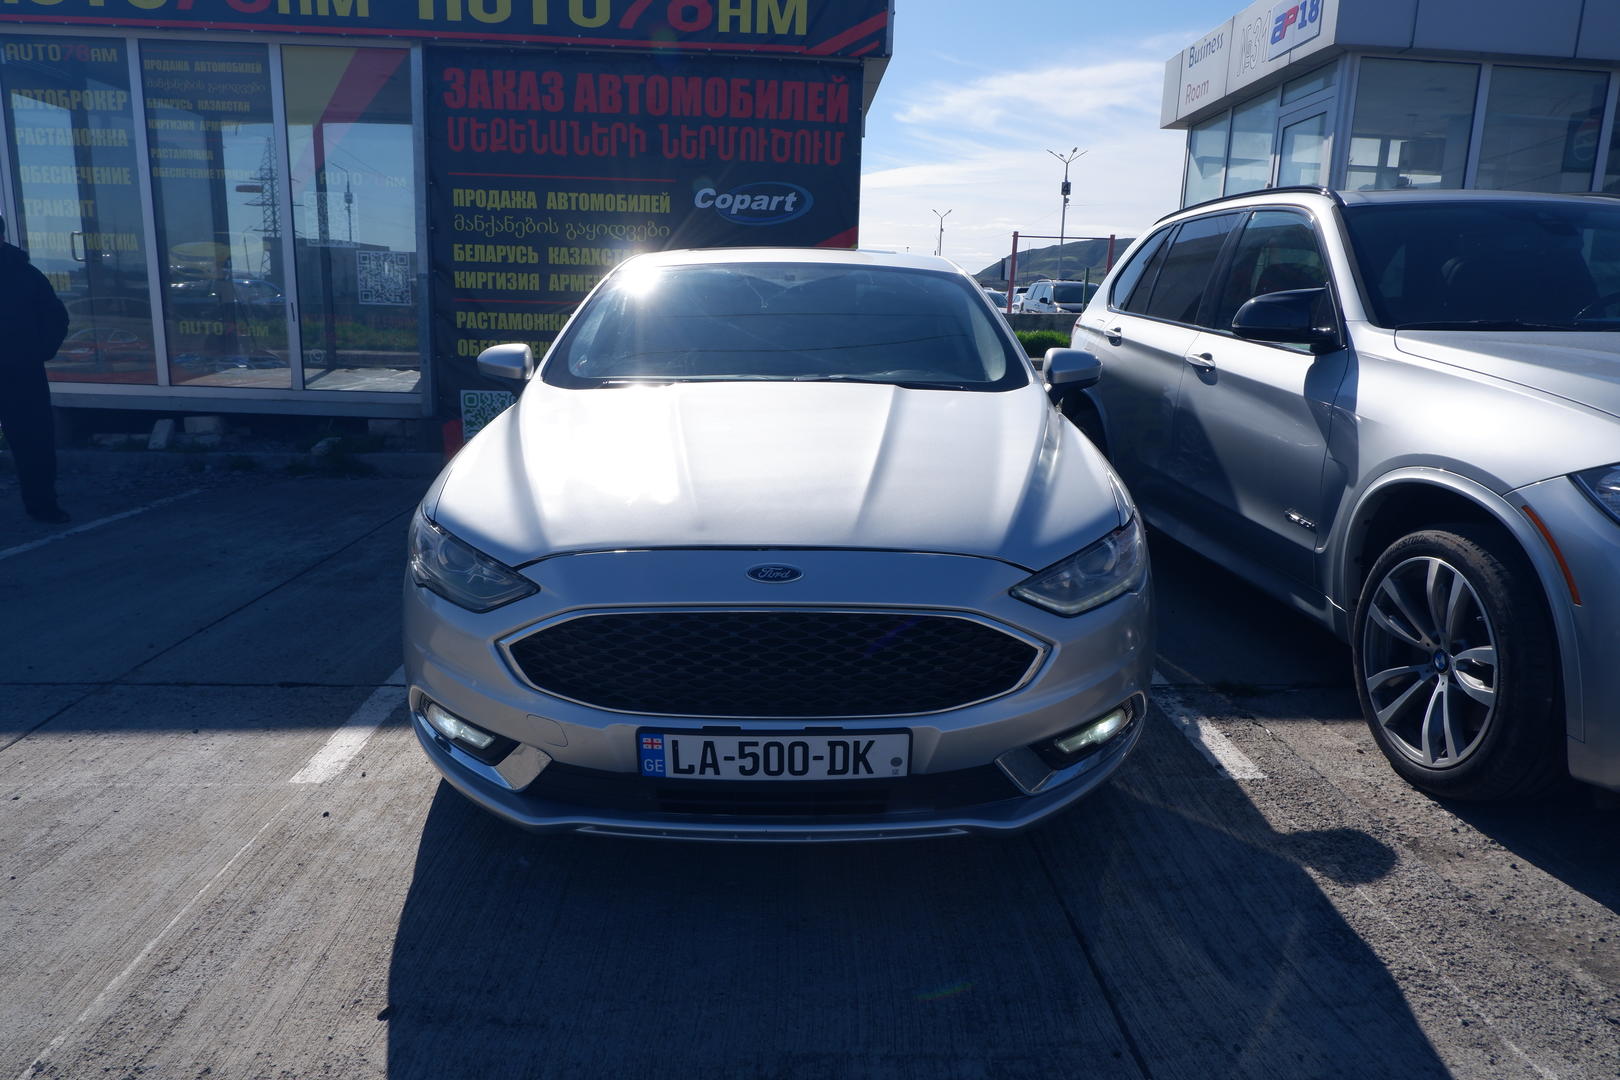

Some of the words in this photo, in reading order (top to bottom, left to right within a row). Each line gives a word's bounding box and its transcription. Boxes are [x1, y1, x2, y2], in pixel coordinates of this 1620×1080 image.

[5, 43, 117, 62] AUTO78AM
[1188, 32, 1224, 68] Business
[11, 89, 127, 112] АВТОБРОКЕР
[443, 68, 564, 112] ЗАКАЗ
[574, 72, 849, 123] АВТОМОБИЛЕЙ
[1185, 79, 1209, 105] Room
[16, 127, 129, 147] РАСТАМОЖКА
[453, 188, 538, 211] ПРОДАЖА
[547, 191, 671, 213] АВТОМОБИЛЕЙ
[694, 187, 797, 215] Copart
[454, 214, 559, 239] მანქანების
[565, 220, 671, 241] გაყიდვები
[453, 243, 539, 264] БЕЛАРУСЬ
[454, 271, 540, 291] КИРГИЗИЯ
[643, 759, 665, 773] GE
[671, 739, 876, 777] LA-500-DK
